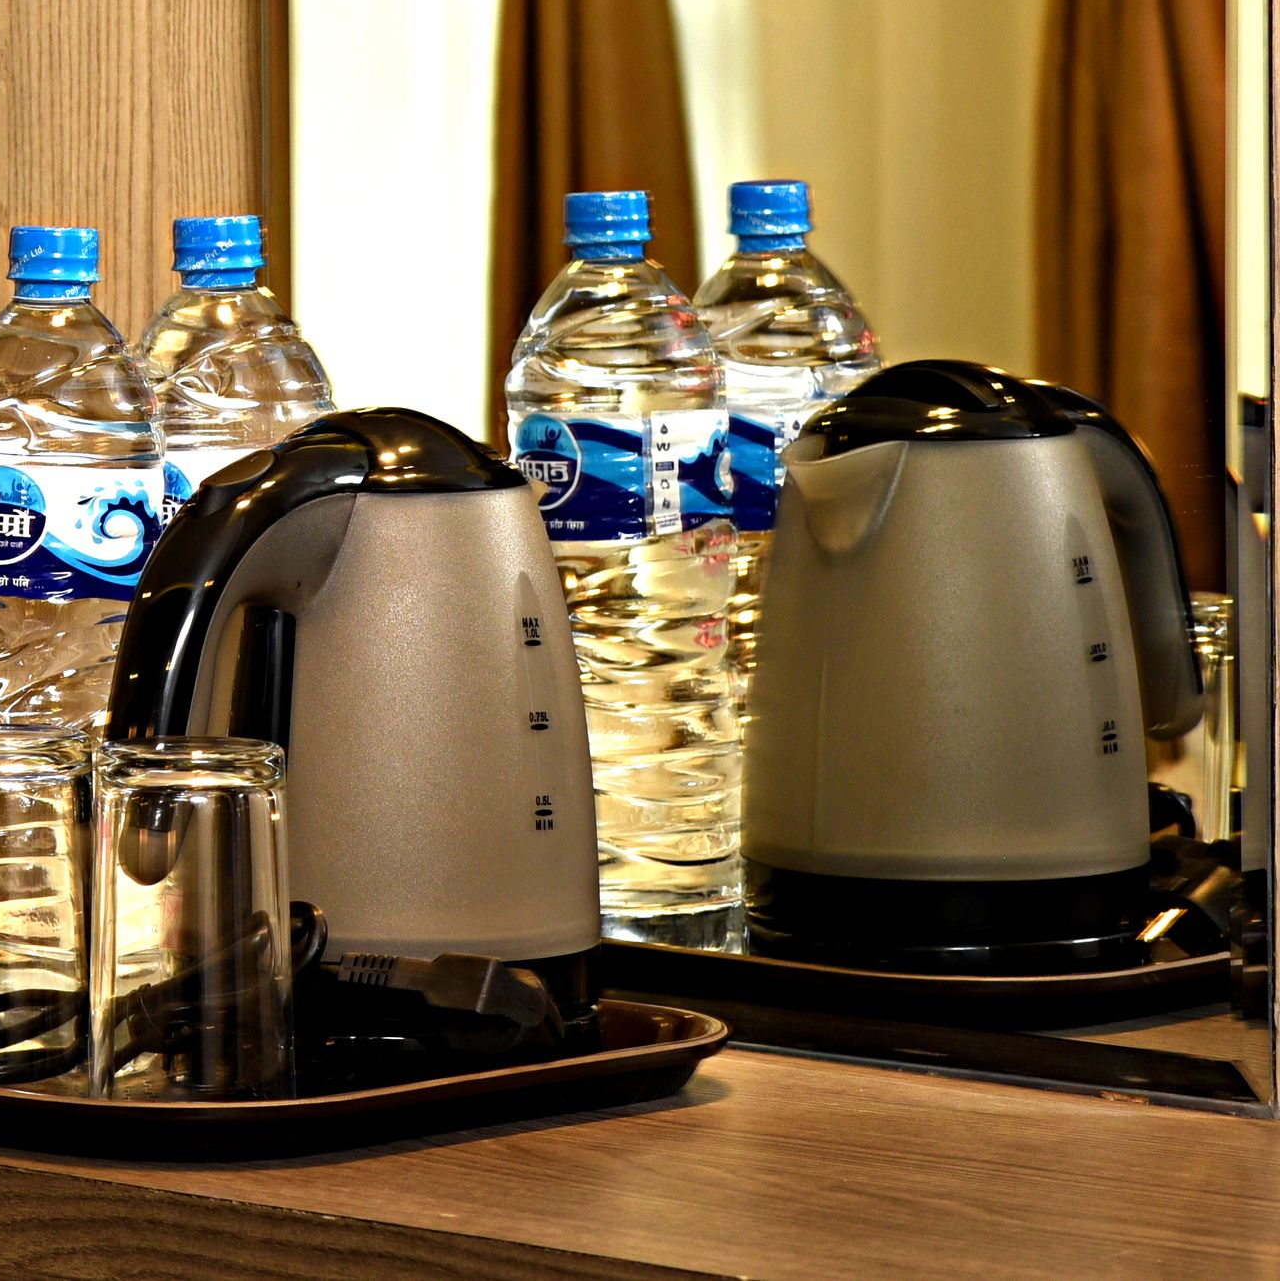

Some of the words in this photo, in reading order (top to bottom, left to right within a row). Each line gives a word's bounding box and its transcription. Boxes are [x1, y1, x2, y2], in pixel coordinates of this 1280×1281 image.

[12, 575, 31, 588] पनि
[522, 617, 540, 629] MAX
[525, 629, 540, 639] 1.0L
[529, 712, 549, 722] 0.75L
[536, 796, 552, 806] 0.5L
[536, 819, 553, 830] MIN
